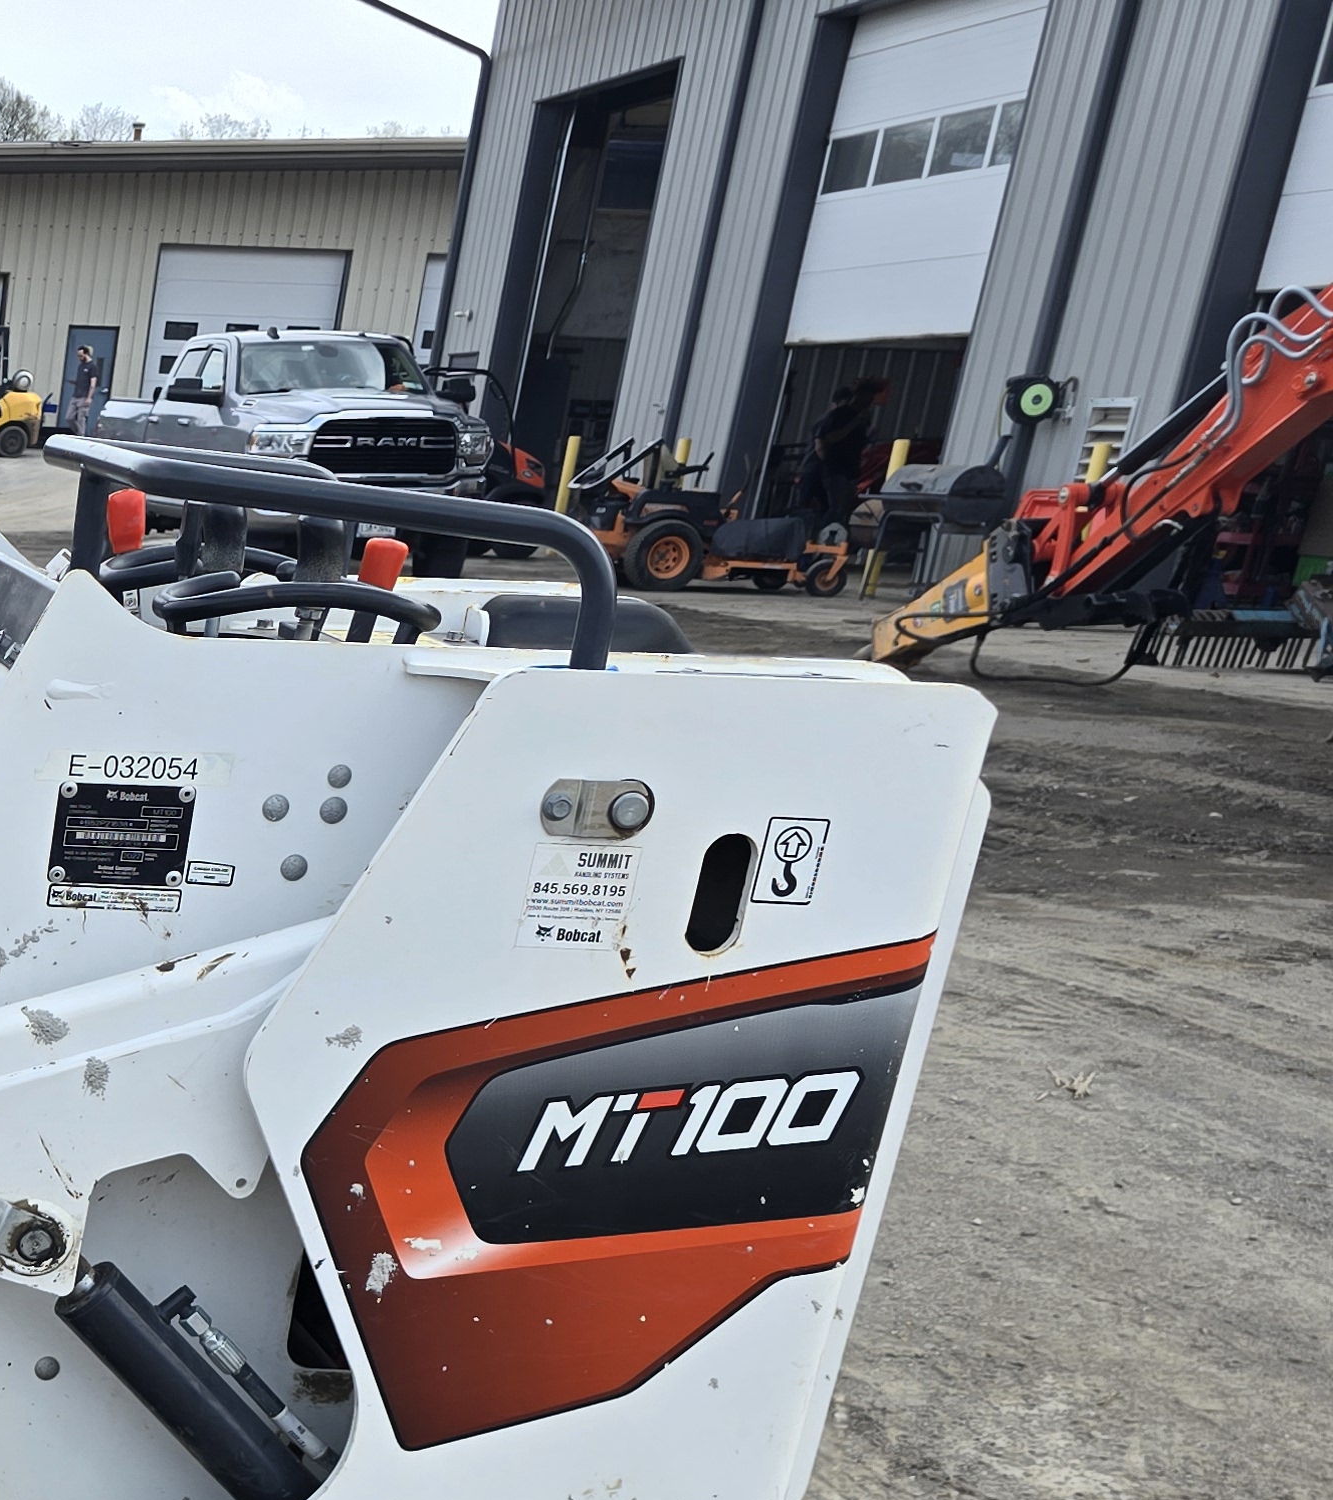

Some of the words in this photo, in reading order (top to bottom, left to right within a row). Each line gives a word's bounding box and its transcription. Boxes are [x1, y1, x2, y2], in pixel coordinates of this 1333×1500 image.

[356, 437, 418, 447] RAM
[68, 754, 199, 780] E-032054
[119, 791, 150, 802] Bobcat
[577, 852, 633, 870] SUMMIT
[603, 872, 630, 881] SYSTEMS
[65, 891, 97, 902] Bobcat
[533, 882, 627, 897] 845.569.8195
[556, 928, 602, 943] Bobcat
[516, 1070, 860, 1172] MT100
